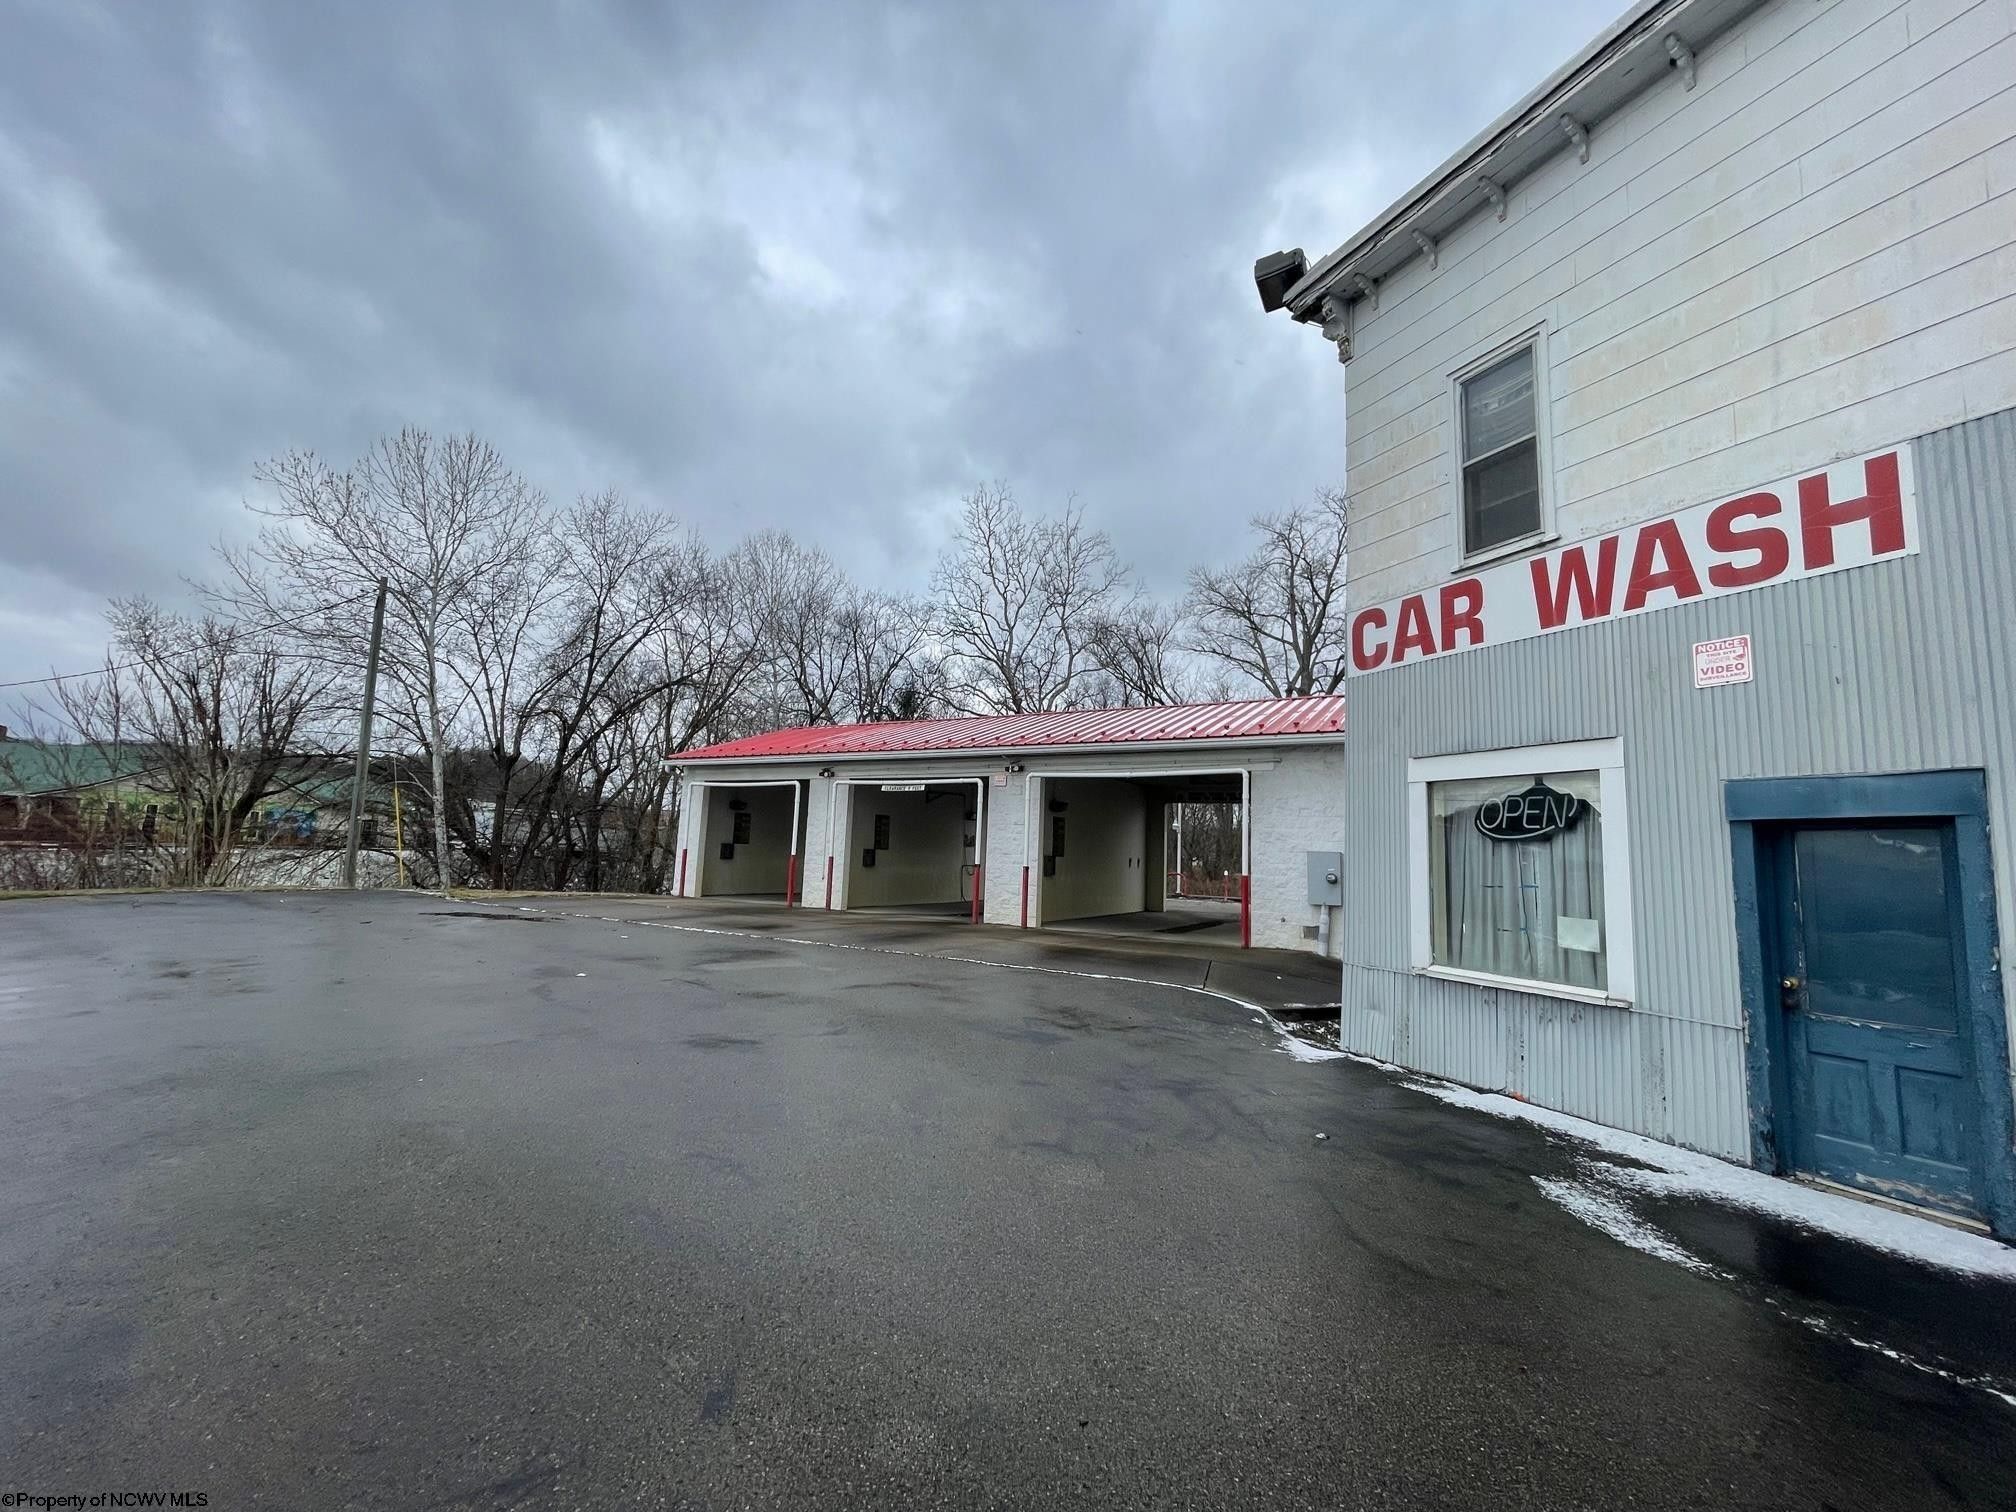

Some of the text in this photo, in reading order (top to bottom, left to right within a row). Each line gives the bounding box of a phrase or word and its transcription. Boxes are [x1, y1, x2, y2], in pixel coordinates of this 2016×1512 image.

[1352, 451, 1906, 671] CAR WASH
[1701, 662, 1745, 676] VIDEO
[1481, 796, 1568, 829] OPEN
